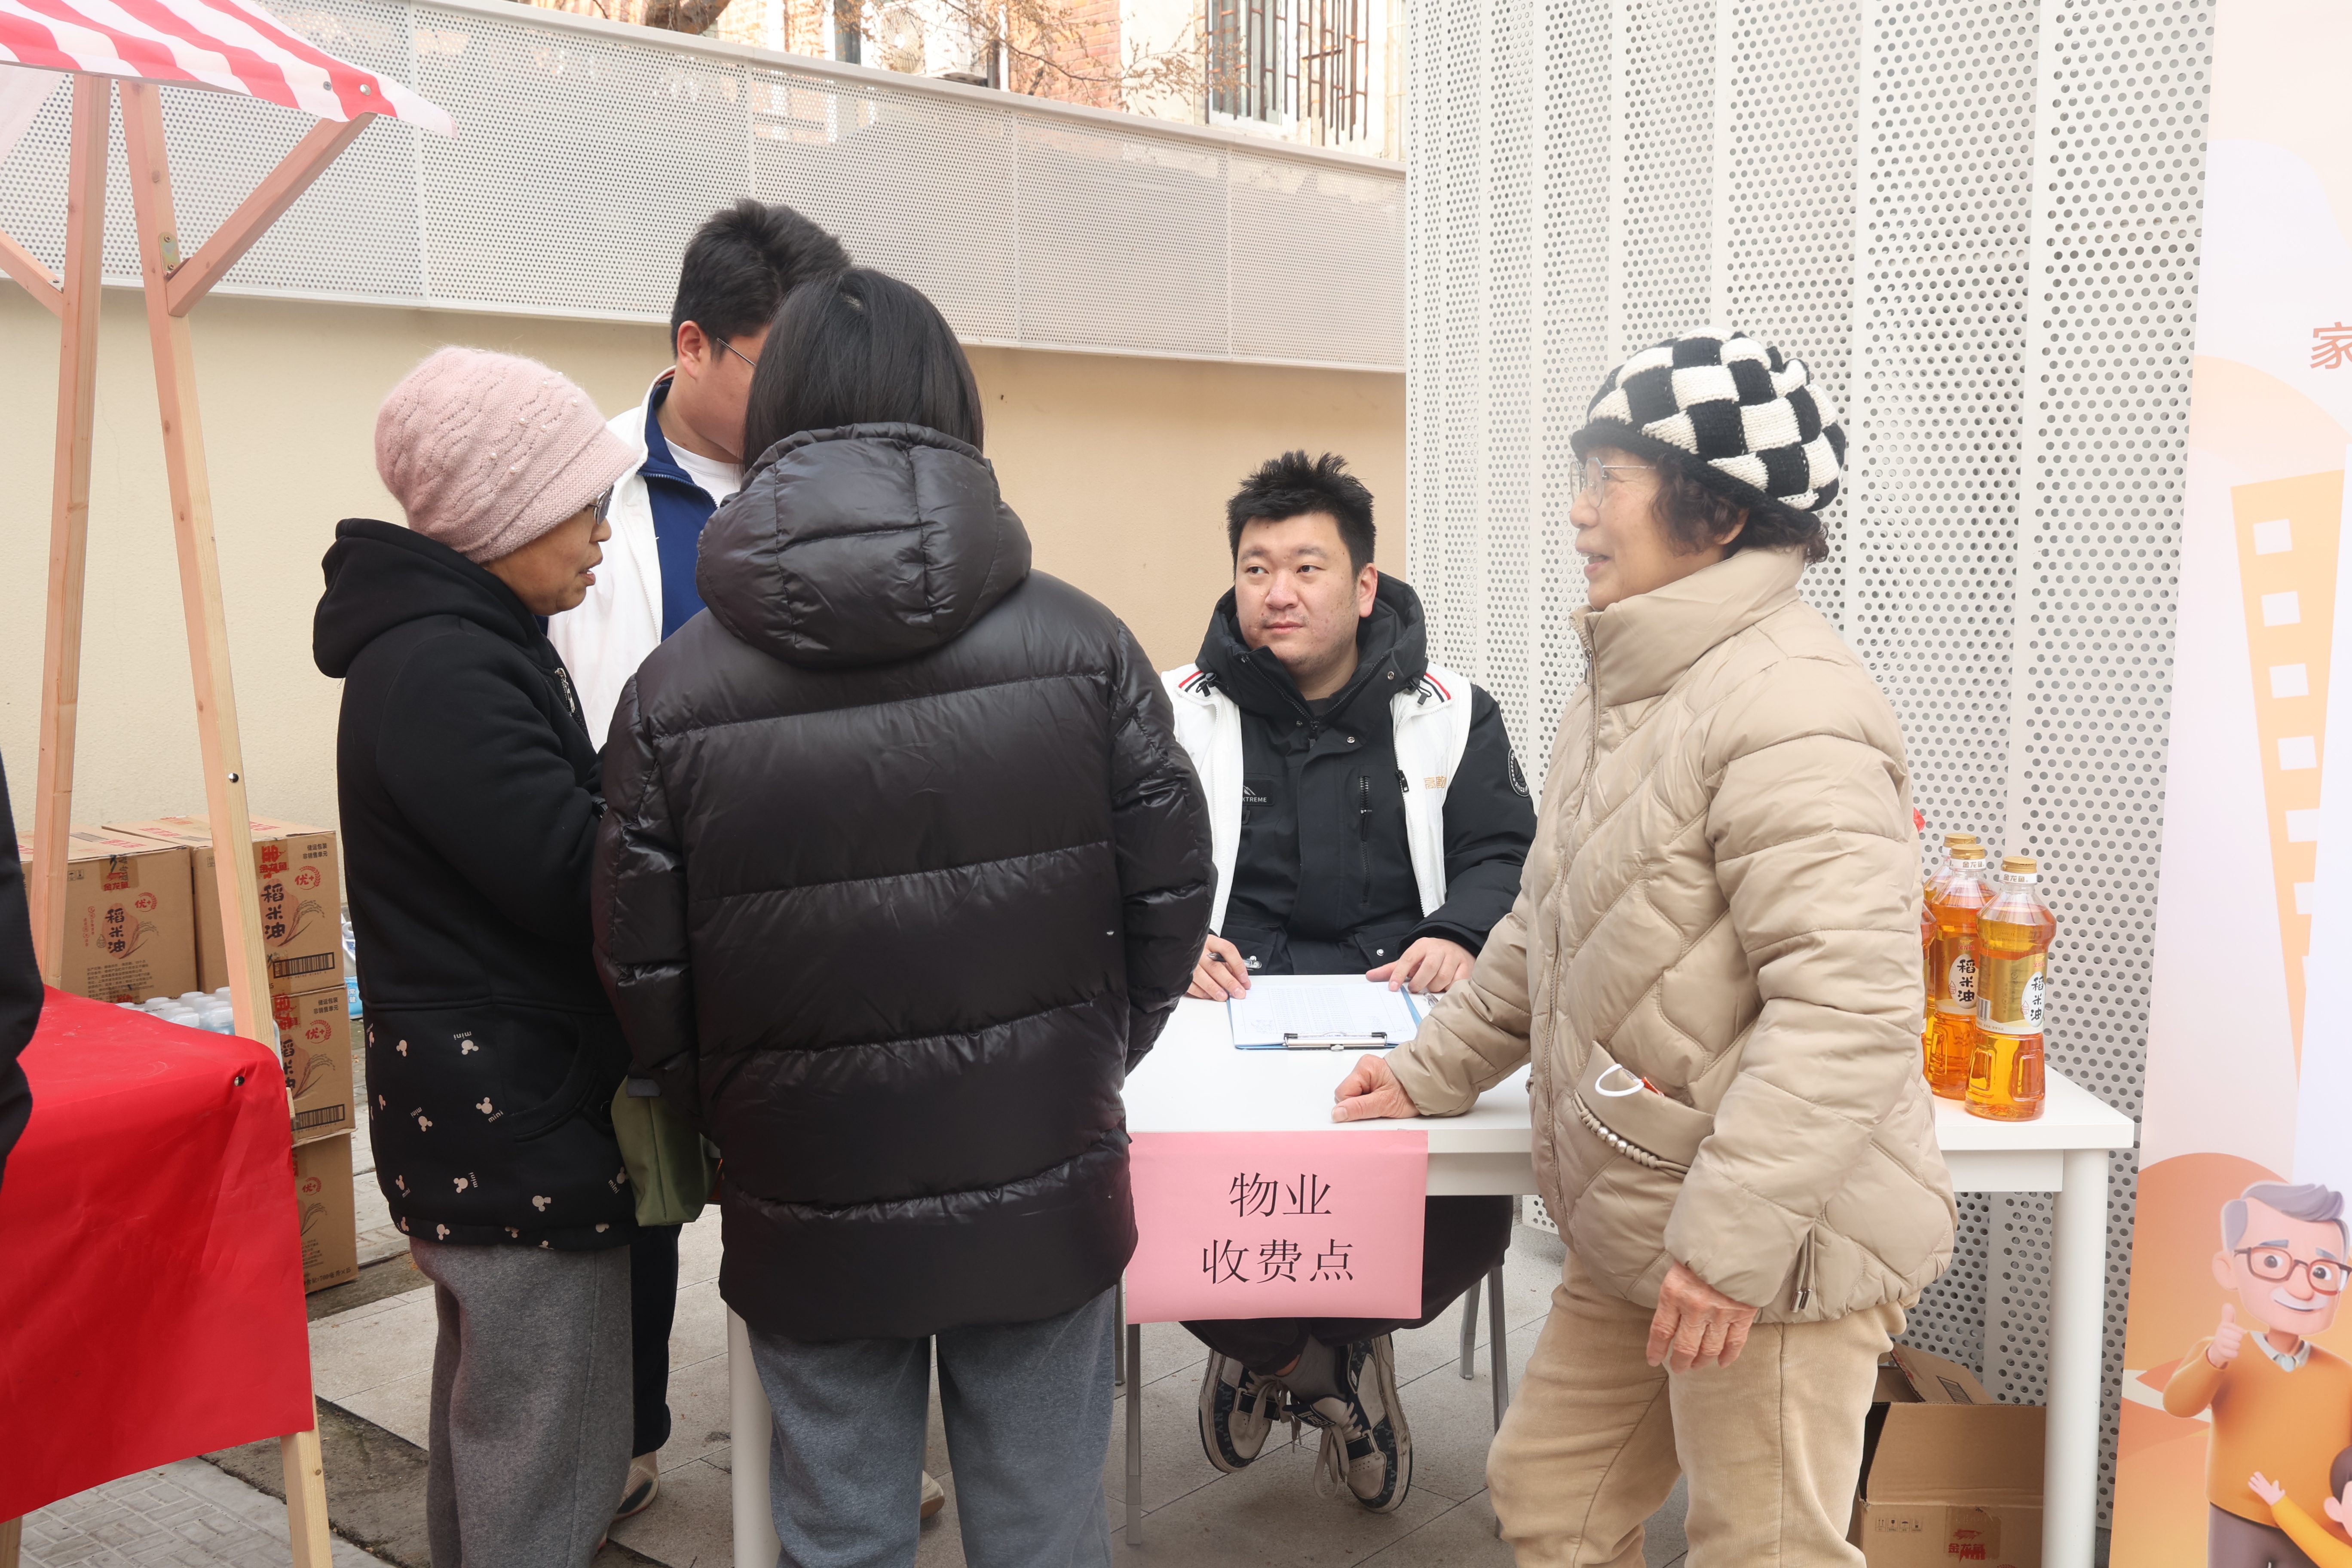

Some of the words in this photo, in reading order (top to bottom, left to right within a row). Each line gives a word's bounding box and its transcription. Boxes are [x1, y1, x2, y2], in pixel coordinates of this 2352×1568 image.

[2310, 322, 2352, 370] 家
[307, 843, 328, 851] 储运包装
[303, 851, 328, 860] 非销售单元
[2003, 873, 2025, 882] 金龙鱼
[103, 881, 131, 891] 金龙鱼
[261, 883, 285, 940] 稻米油
[105, 907, 126, 954] 稻米油
[1957, 959, 1976, 1002] 稻米油
[318, 997, 338, 1006] 储运包装
[2030, 976, 2044, 1021] 稻米油
[313, 1004, 339, 1014] 非销售单元
[453, 1031, 472, 1040] mini
[410, 1106, 423, 1118] mini
[488, 1109, 504, 1123] mini
[468, 1172, 478, 1188] mini
[608, 1179, 620, 1194] mini
[402, 1187, 411, 1198] mini
[1230, 1173, 1331, 1217] 物业
[1203, 1239, 1353, 1284] 收费点
